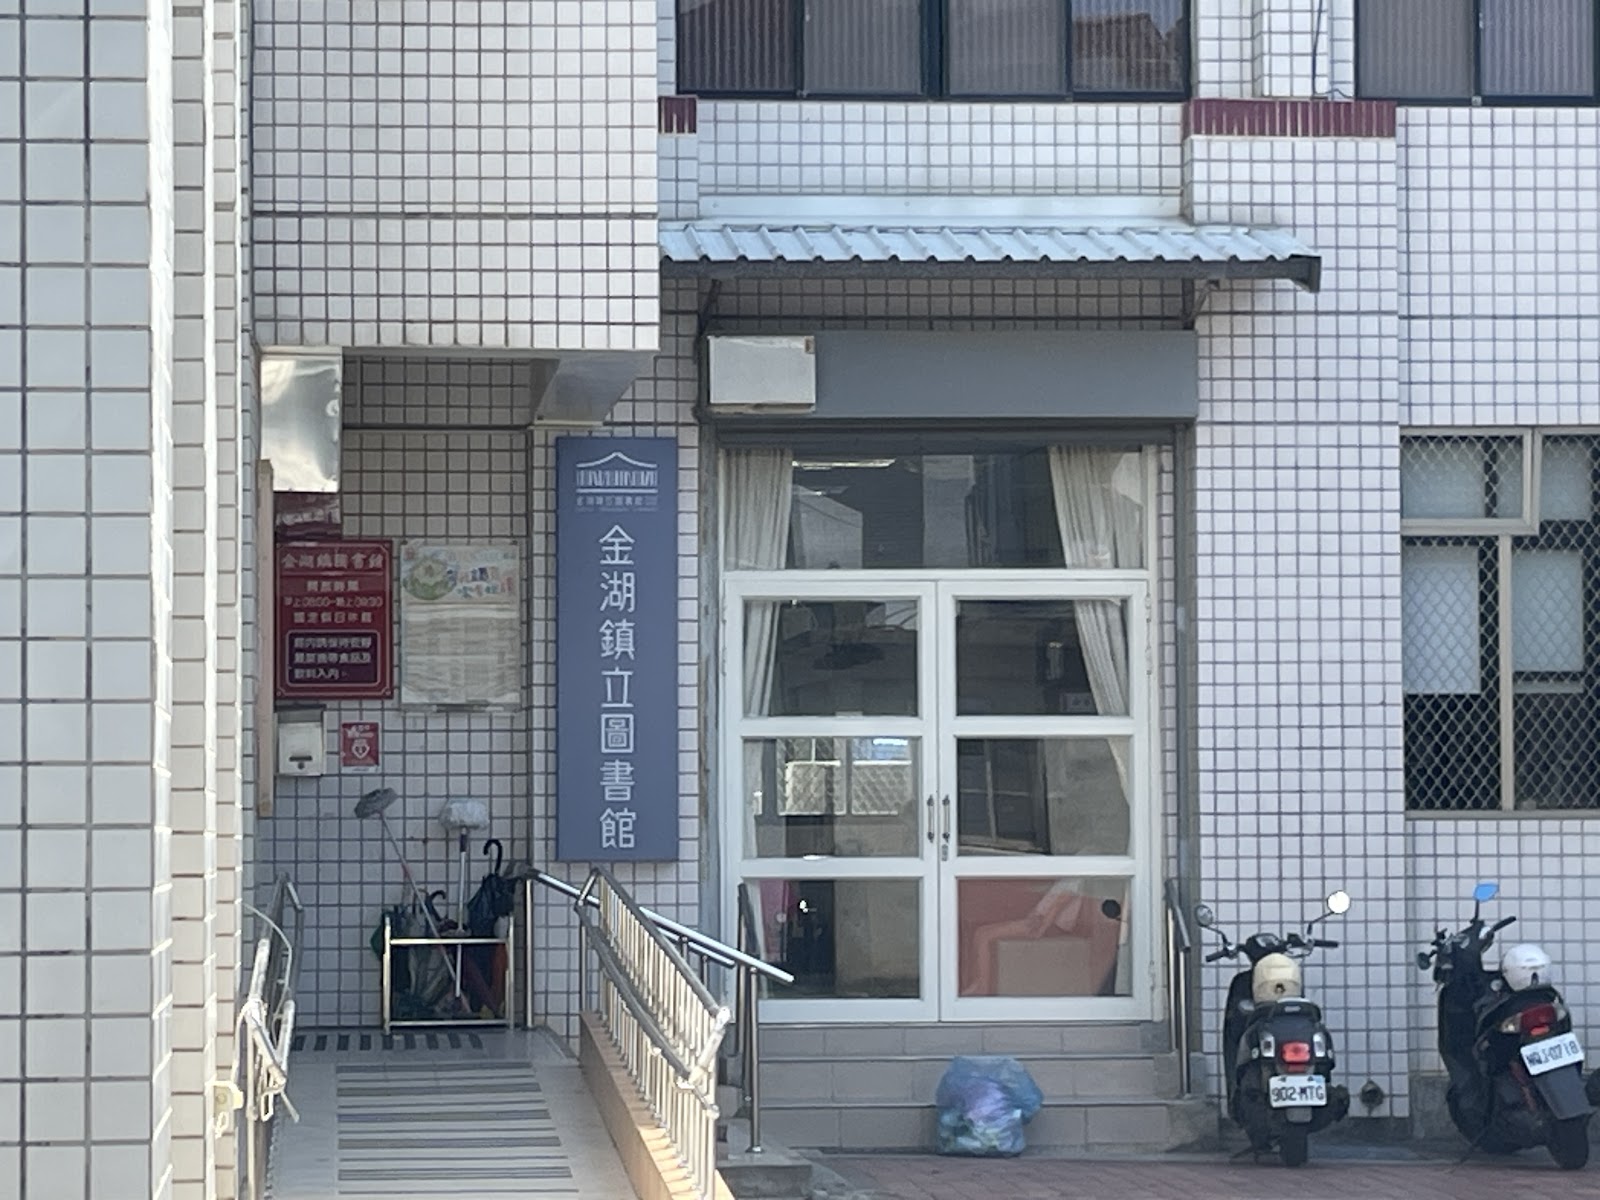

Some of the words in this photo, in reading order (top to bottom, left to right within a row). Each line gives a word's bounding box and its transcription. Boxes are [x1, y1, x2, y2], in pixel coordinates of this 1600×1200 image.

[599, 524, 636, 849] 金湖鎮立圖書館
[1272, 1085, 1325, 1102] 902-MTG
